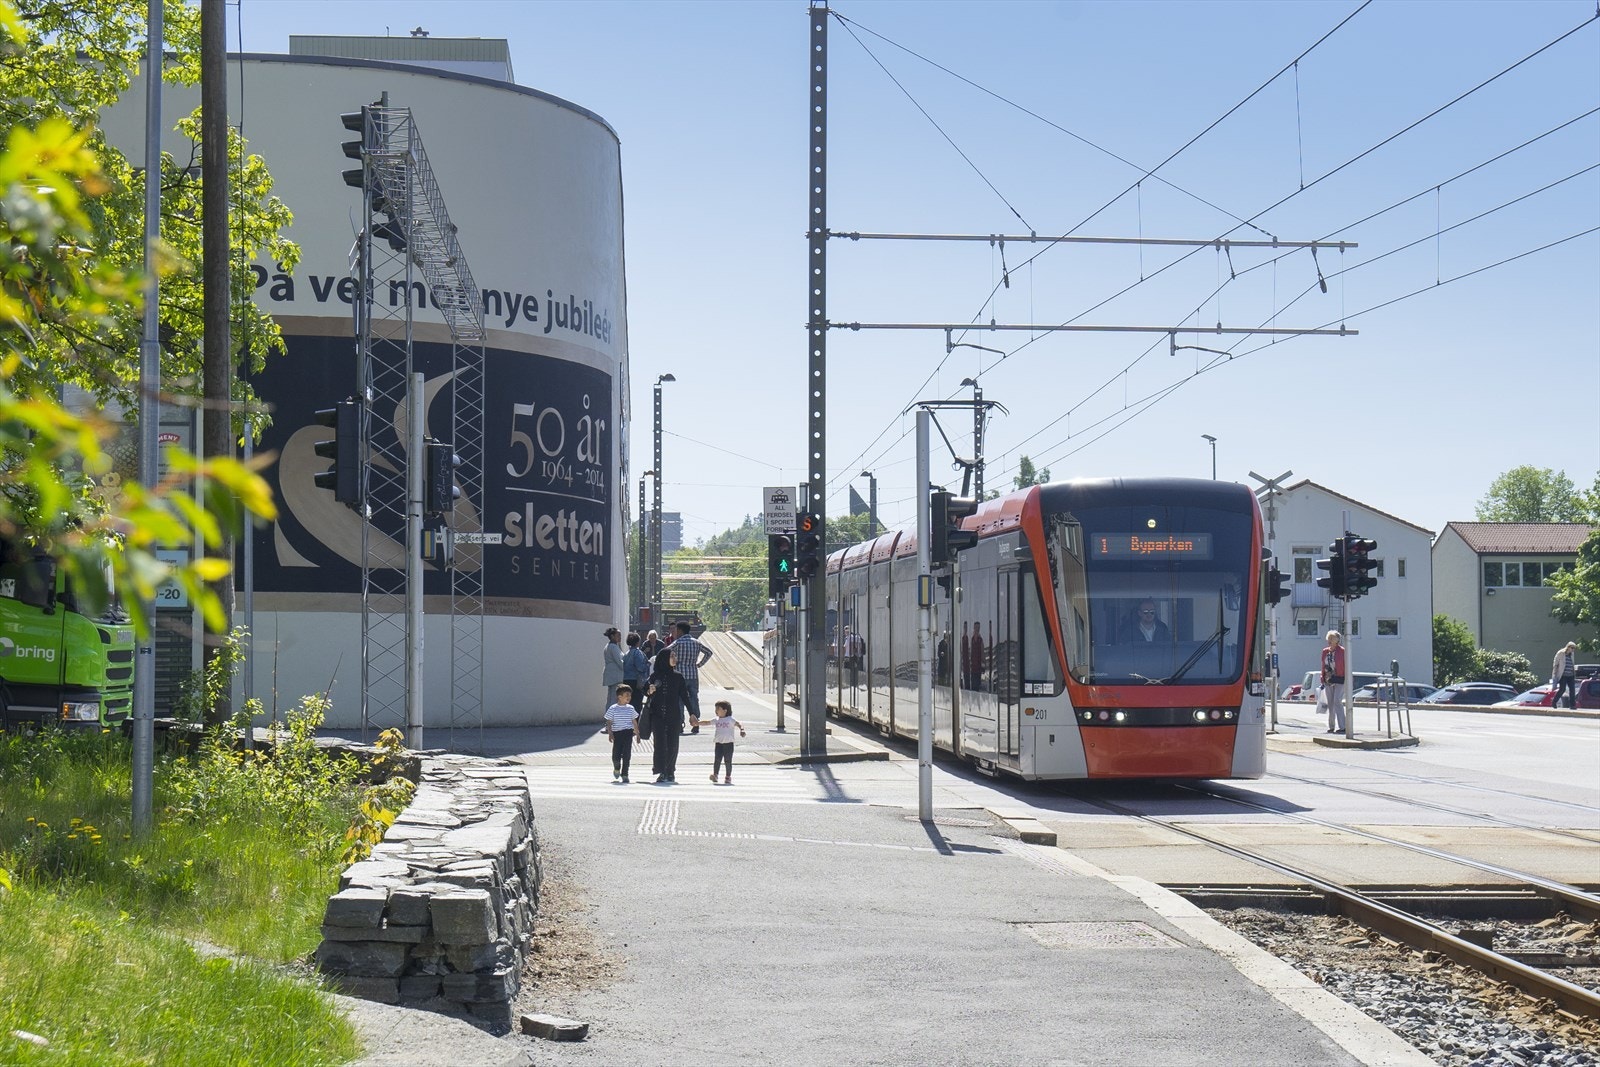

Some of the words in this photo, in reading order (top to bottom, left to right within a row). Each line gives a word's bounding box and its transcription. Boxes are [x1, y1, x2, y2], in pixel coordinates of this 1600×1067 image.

[482, 288, 539, 328] nye
[506, 401, 565, 478] 50
[576, 393, 605, 466] år
[541, 456, 574, 487] 1964
[585, 468, 604, 488] 2014
[490, 535, 500, 543] vei
[503, 502, 603, 556] sletten
[1101, 538, 1108, 553] 1
[1131, 536, 1193, 554] Byparken
[511, 556, 600, 581] SENTER
[15, 645, 56, 662] bring
[1035, 709, 1047, 720] 201
